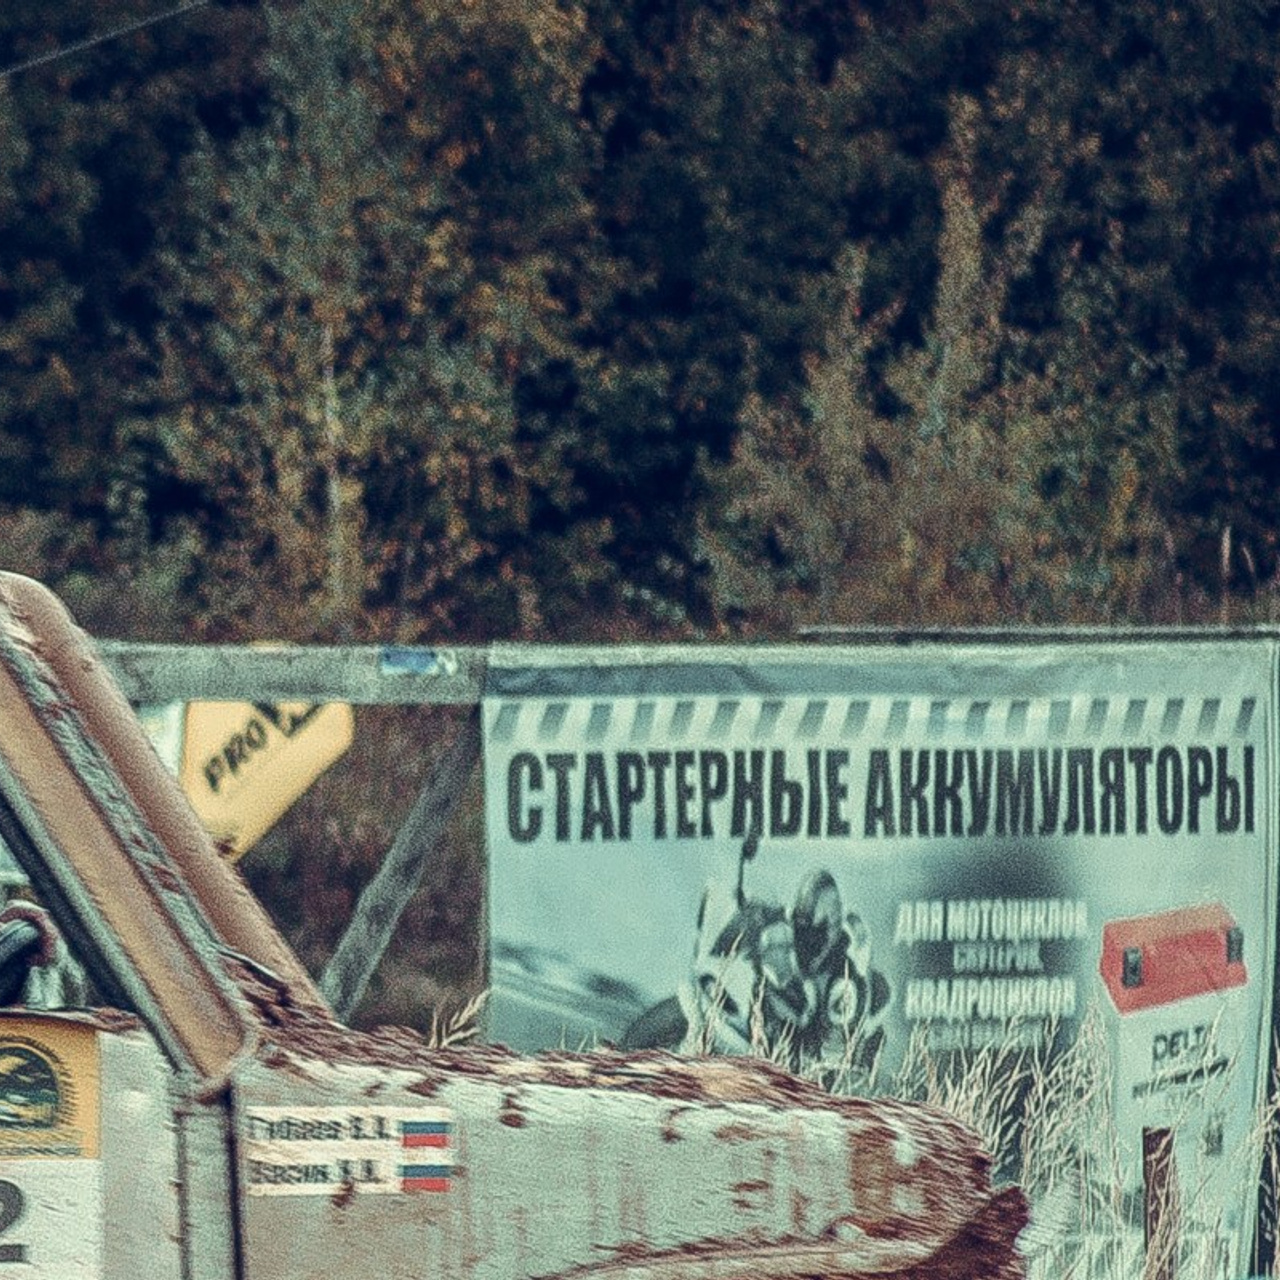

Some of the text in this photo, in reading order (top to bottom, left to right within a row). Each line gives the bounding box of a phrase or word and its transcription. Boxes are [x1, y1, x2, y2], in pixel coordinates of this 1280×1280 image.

[202, 718, 268, 793] PRO
[507, 744, 1256, 843] СТАРТЕРНЫЕ АККУМУЛЯТОРЫ
[894, 901, 944, 946] ДЛЯ
